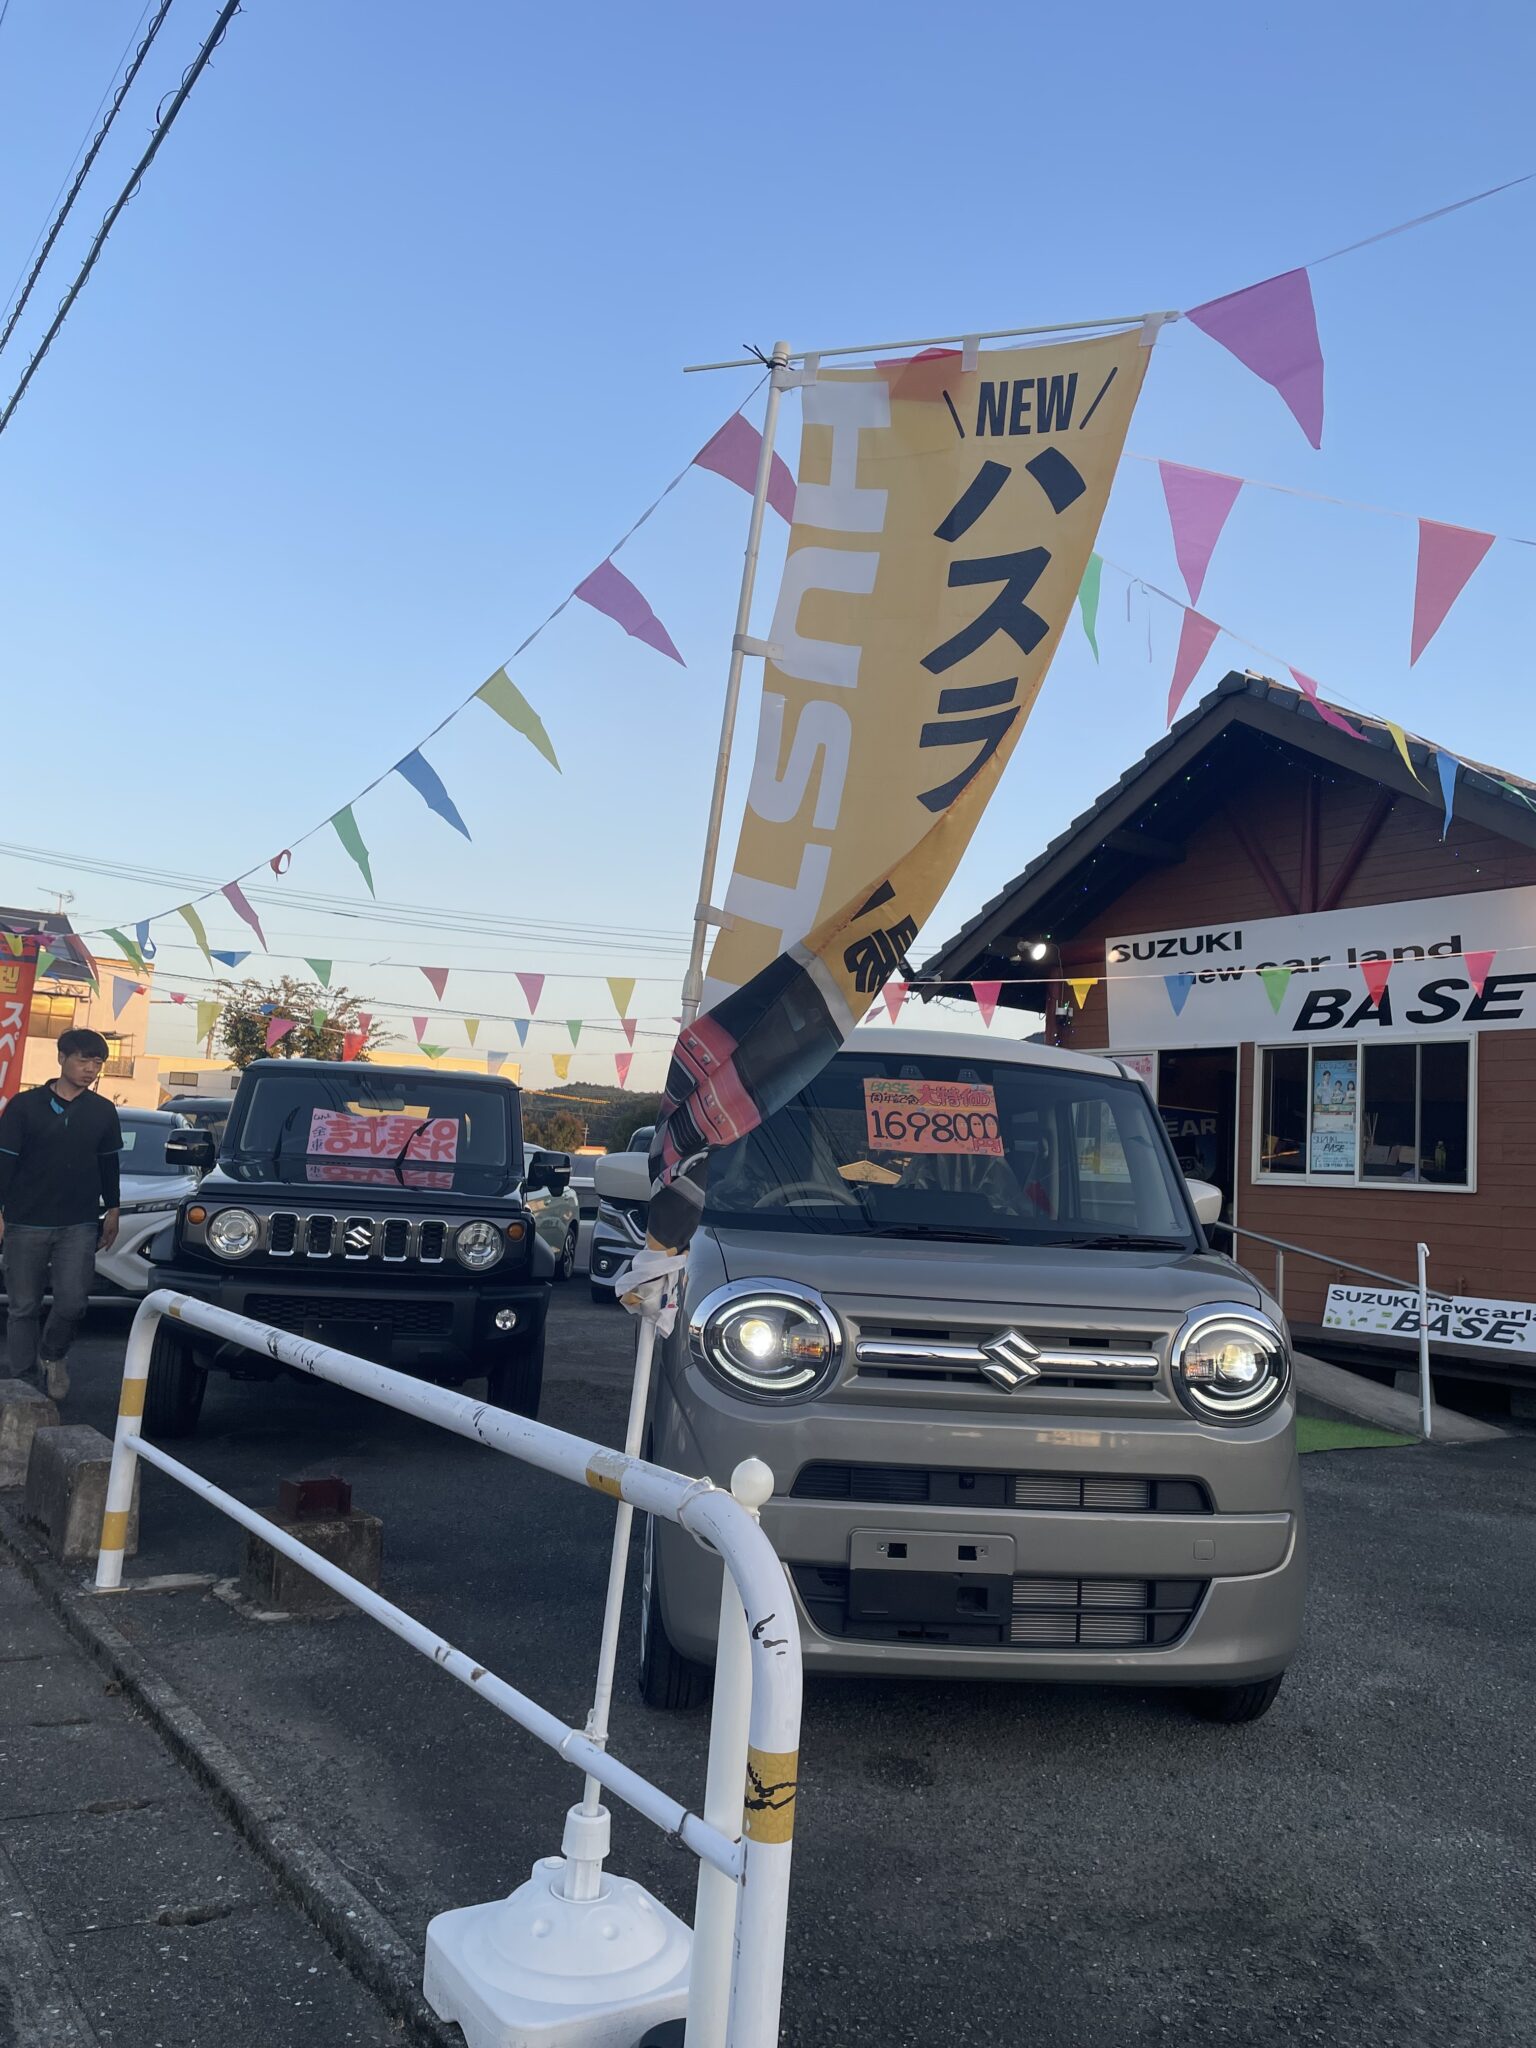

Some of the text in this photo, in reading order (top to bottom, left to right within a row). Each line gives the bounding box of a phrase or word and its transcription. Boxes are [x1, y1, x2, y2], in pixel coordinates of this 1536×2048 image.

[976, 373, 1078, 437] NEW
[700, 380, 890, 1015] HUST
[1111, 930, 1243, 963] SUZUKI
[1178, 934, 1461, 985] new car land
[1292, 973, 1536, 1031] BASE
[870, 1081, 911, 1094] BASE
[1323, 1143, 1345, 1153] BASE
[1330, 1289, 1418, 1310] SUZUKI
[1391, 1310, 1527, 1344] BASE
